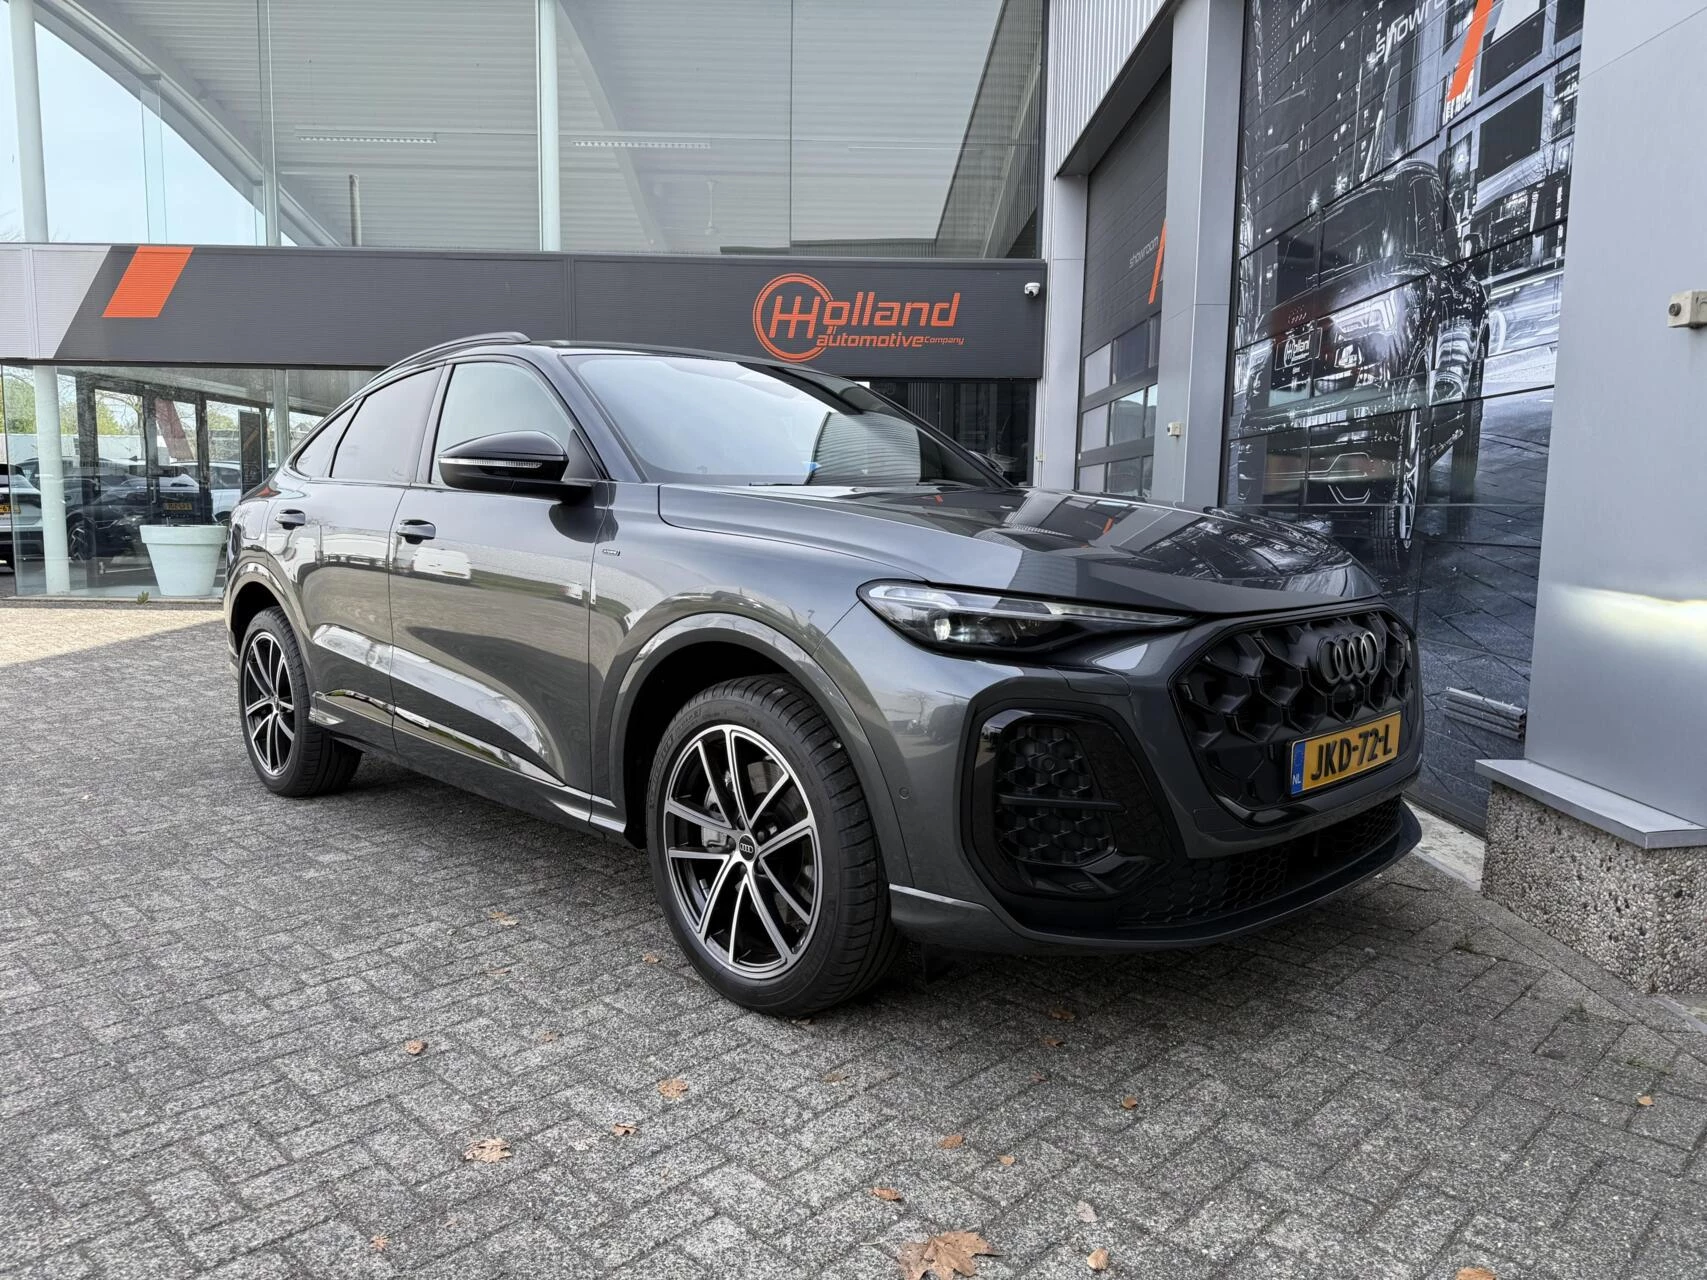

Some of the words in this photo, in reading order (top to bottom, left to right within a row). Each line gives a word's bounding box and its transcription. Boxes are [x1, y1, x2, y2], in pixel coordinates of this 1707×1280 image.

[769, 292, 961, 338] Holland
[816, 332, 924, 348] automotive
[1312, 725, 1392, 781] JKD-72-L
[1292, 773, 1302, 785] NL
